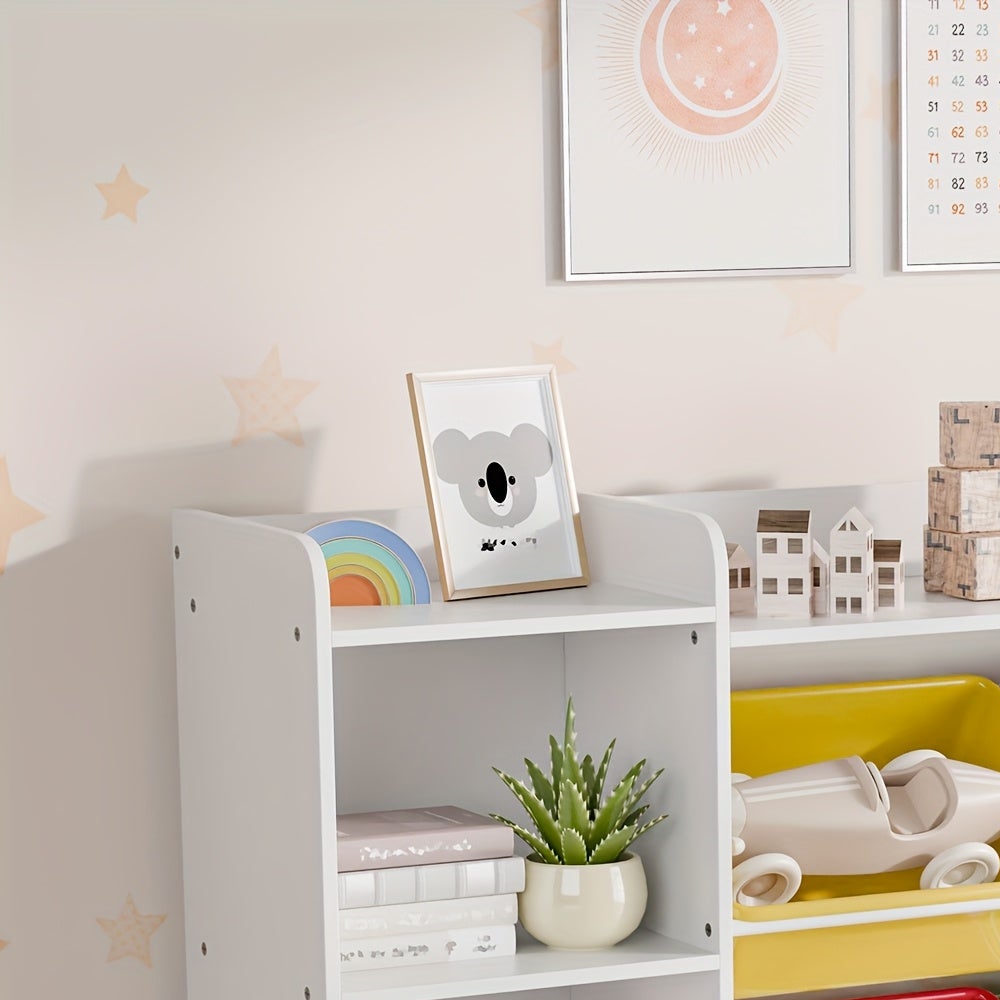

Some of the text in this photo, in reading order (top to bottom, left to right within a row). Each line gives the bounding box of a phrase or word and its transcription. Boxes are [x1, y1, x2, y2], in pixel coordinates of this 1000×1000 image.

[928, 0, 939, 10] 11
[953, 0, 965, 10] 12
[977, 0, 988, 10] 13
[928, 24, 938, 35] 21
[952, 24, 964, 35] 22
[976, 24, 988, 36] 23
[928, 50, 938, 61] 31
[952, 49, 964, 61] 32
[976, 49, 988, 62] 33
[928, 76, 939, 87] 41
[952, 76, 965, 86] 42
[975, 75, 988, 86] 43
[929, 101, 938, 112] 51
[952, 101, 964, 112] 52
[976, 101, 988, 112] 53
[928, 127, 939, 138] 61
[951, 126, 964, 138] 62
[975, 125, 988, 138] 63
[929, 153, 939, 163] 71
[952, 152, 965, 163] 72
[975, 151, 988, 163] 73
[928, 178, 939, 189] 81
[952, 177, 965, 189] 82
[976, 176, 988, 189] 83
[928, 204, 939, 214] 91
[952, 204, 965, 215] 92
[975, 202, 988, 214] 93
